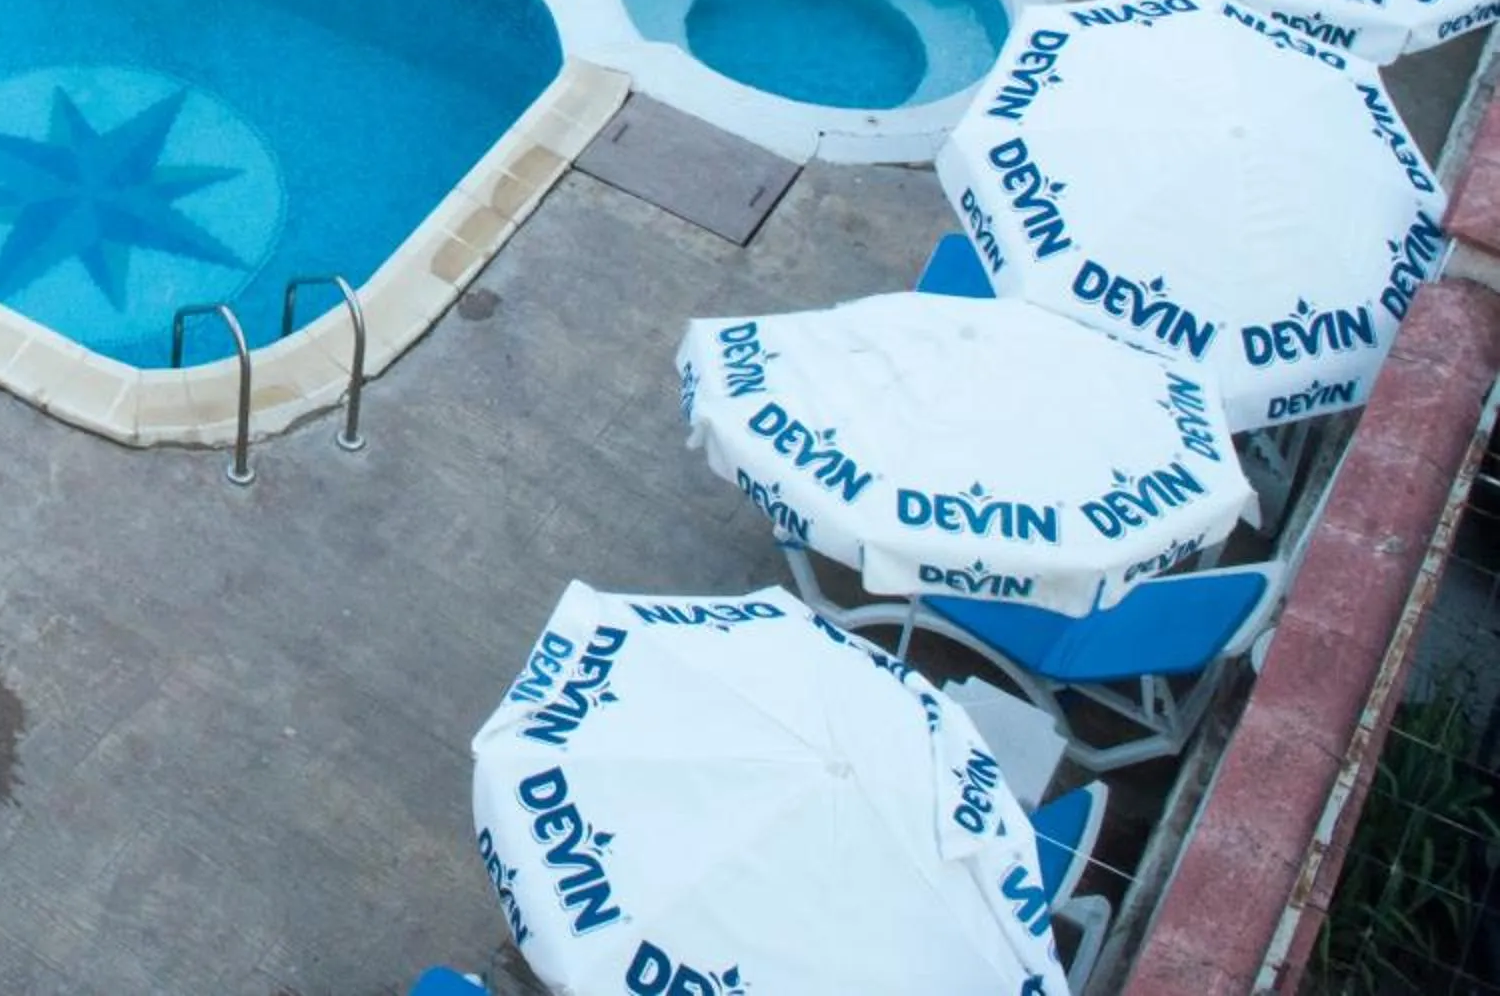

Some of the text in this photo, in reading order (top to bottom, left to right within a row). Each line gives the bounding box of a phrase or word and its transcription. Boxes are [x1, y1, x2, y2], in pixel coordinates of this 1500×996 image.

[988, 30, 1069, 120] DEVIN
[1223, 4, 1346, 70] DEVIN
[1355, 84, 1435, 194] DEVIN
[960, 188, 1004, 274] DEVIN
[989, 137, 1071, 259] DEVIN
[1072, 259, 1217, 358] DEVIN
[1380, 210, 1444, 322] DEVIN
[720, 322, 766, 397] DEVIN
[1241, 306, 1374, 366] DEVIN
[1166, 372, 1221, 462] DEVIN
[1267, 381, 1355, 418] DEVIN
[748, 402, 872, 502] DEVIN
[737, 468, 808, 541] DEVIN
[897, 490, 1057, 542] DEVIN
[1080, 461, 1203, 538] DEVIN
[630, 602, 787, 628] DEVIN
[918, 564, 1032, 597] DEVIN
[953, 748, 1000, 835] DEVIN
[518, 766, 621, 935] DEVIN
